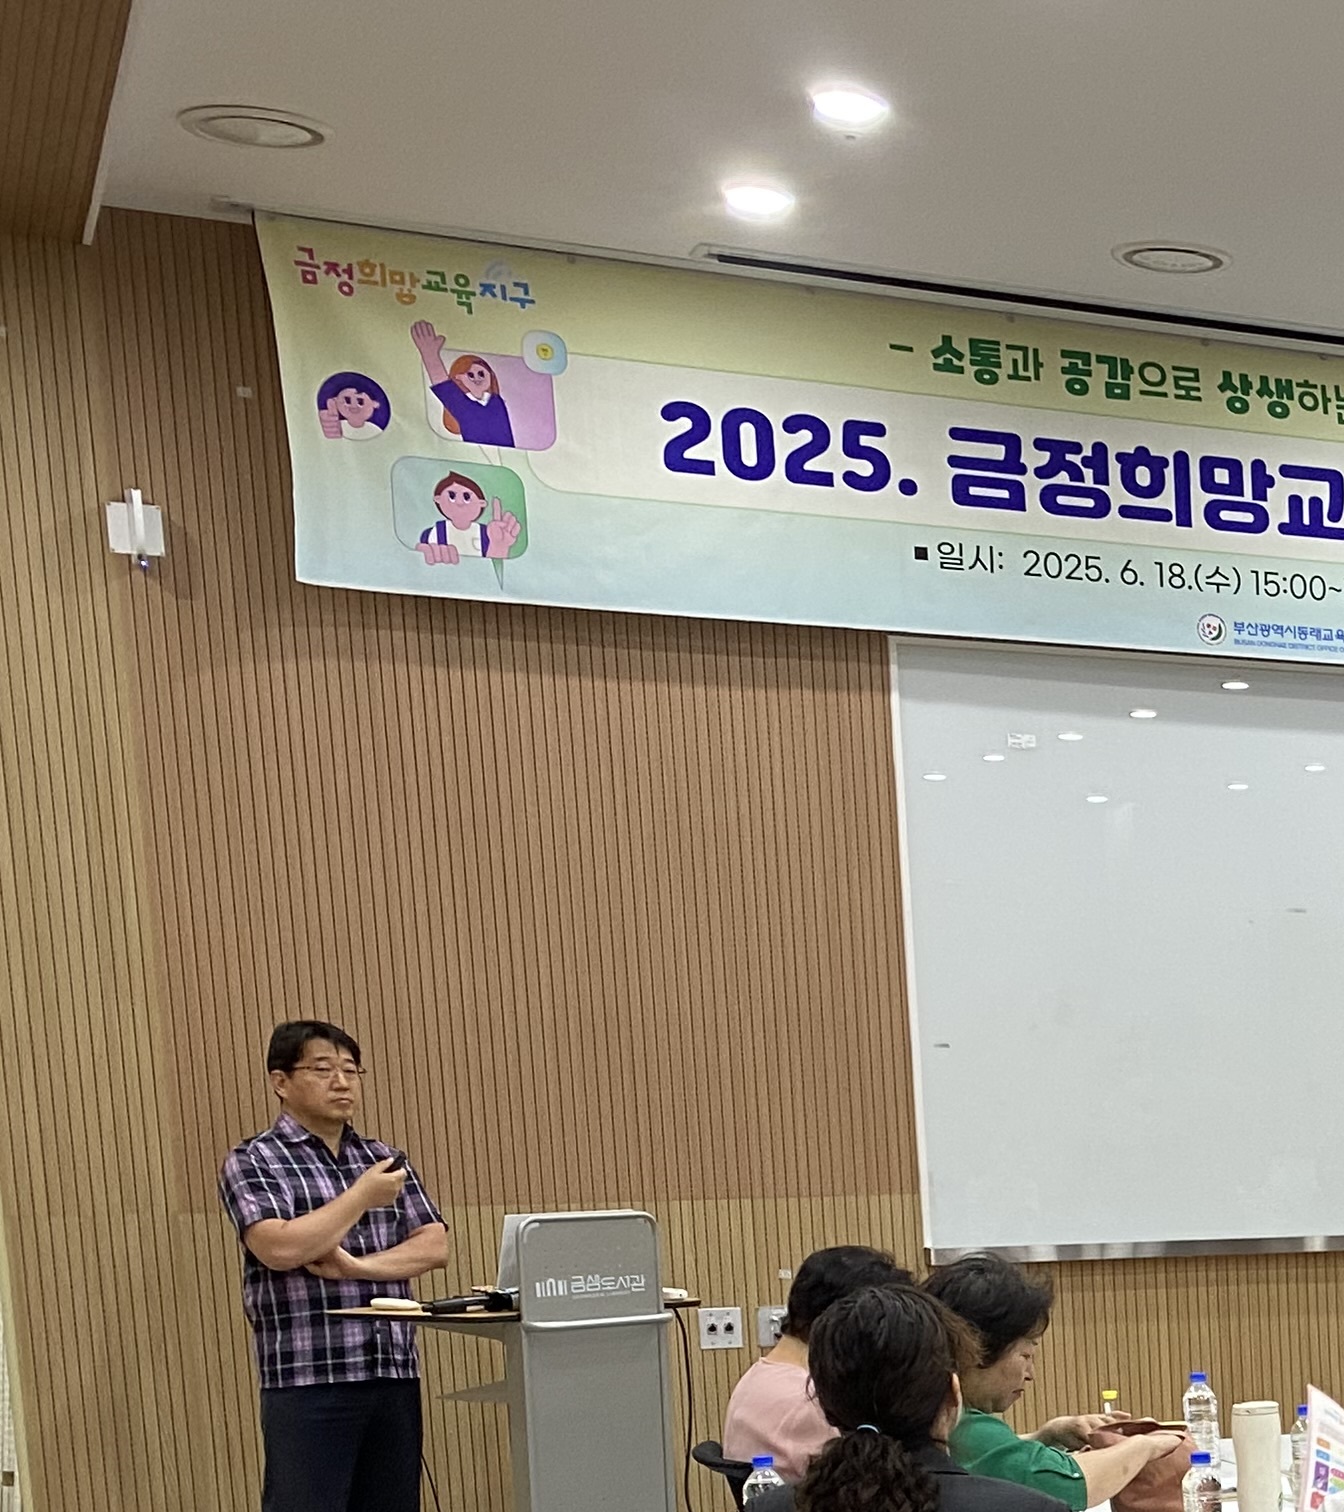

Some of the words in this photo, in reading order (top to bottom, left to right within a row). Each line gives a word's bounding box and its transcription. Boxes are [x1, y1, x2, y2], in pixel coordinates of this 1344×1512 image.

[293, 245, 536, 315] 금정희망교육지구
[930, 334, 1043, 386] 소통과
[1059, 348, 1203, 403] 공감으로
[659, 400, 919, 497] 2025.
[936, 541, 1004, 574] 일시:
[1022, 549, 1110, 584] 2025.
[1119, 559, 1145, 587] 6.
[570, 1274, 646, 1294] 금샘도서관
